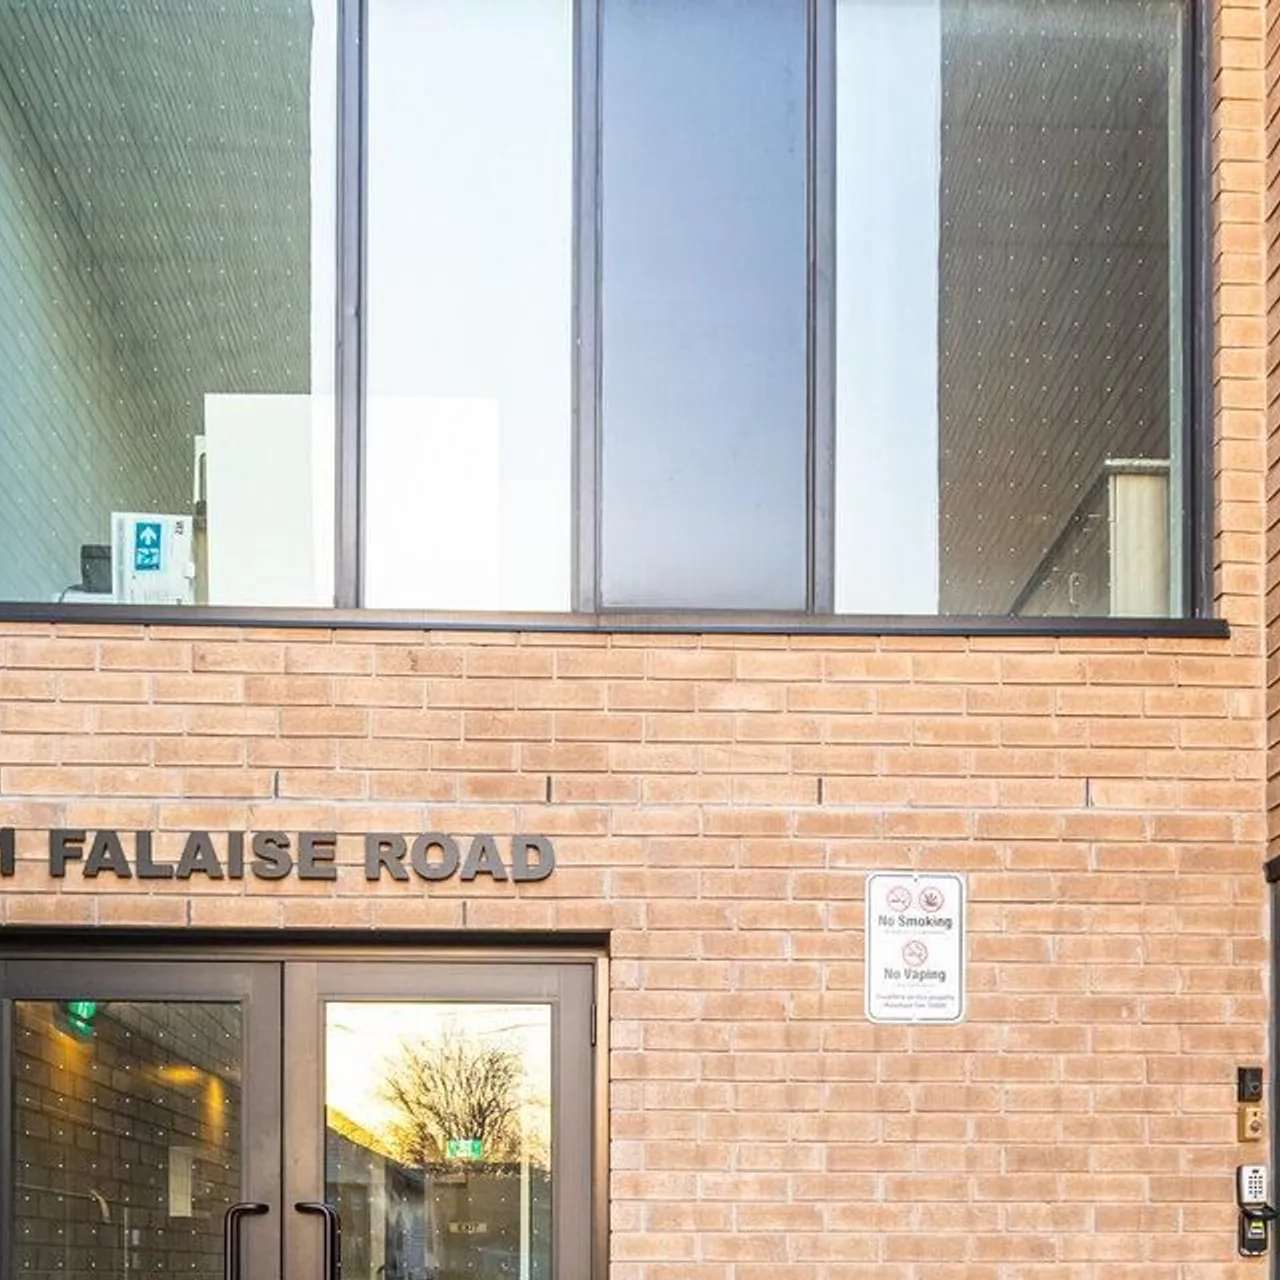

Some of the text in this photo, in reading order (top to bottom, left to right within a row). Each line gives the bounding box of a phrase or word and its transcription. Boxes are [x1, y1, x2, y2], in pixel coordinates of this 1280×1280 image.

[49, 828, 338, 882] FALAISE
[364, 833, 556, 883] ROAD
[878, 915, 953, 930] No Smoking
[884, 968, 946, 982] No Vaping
